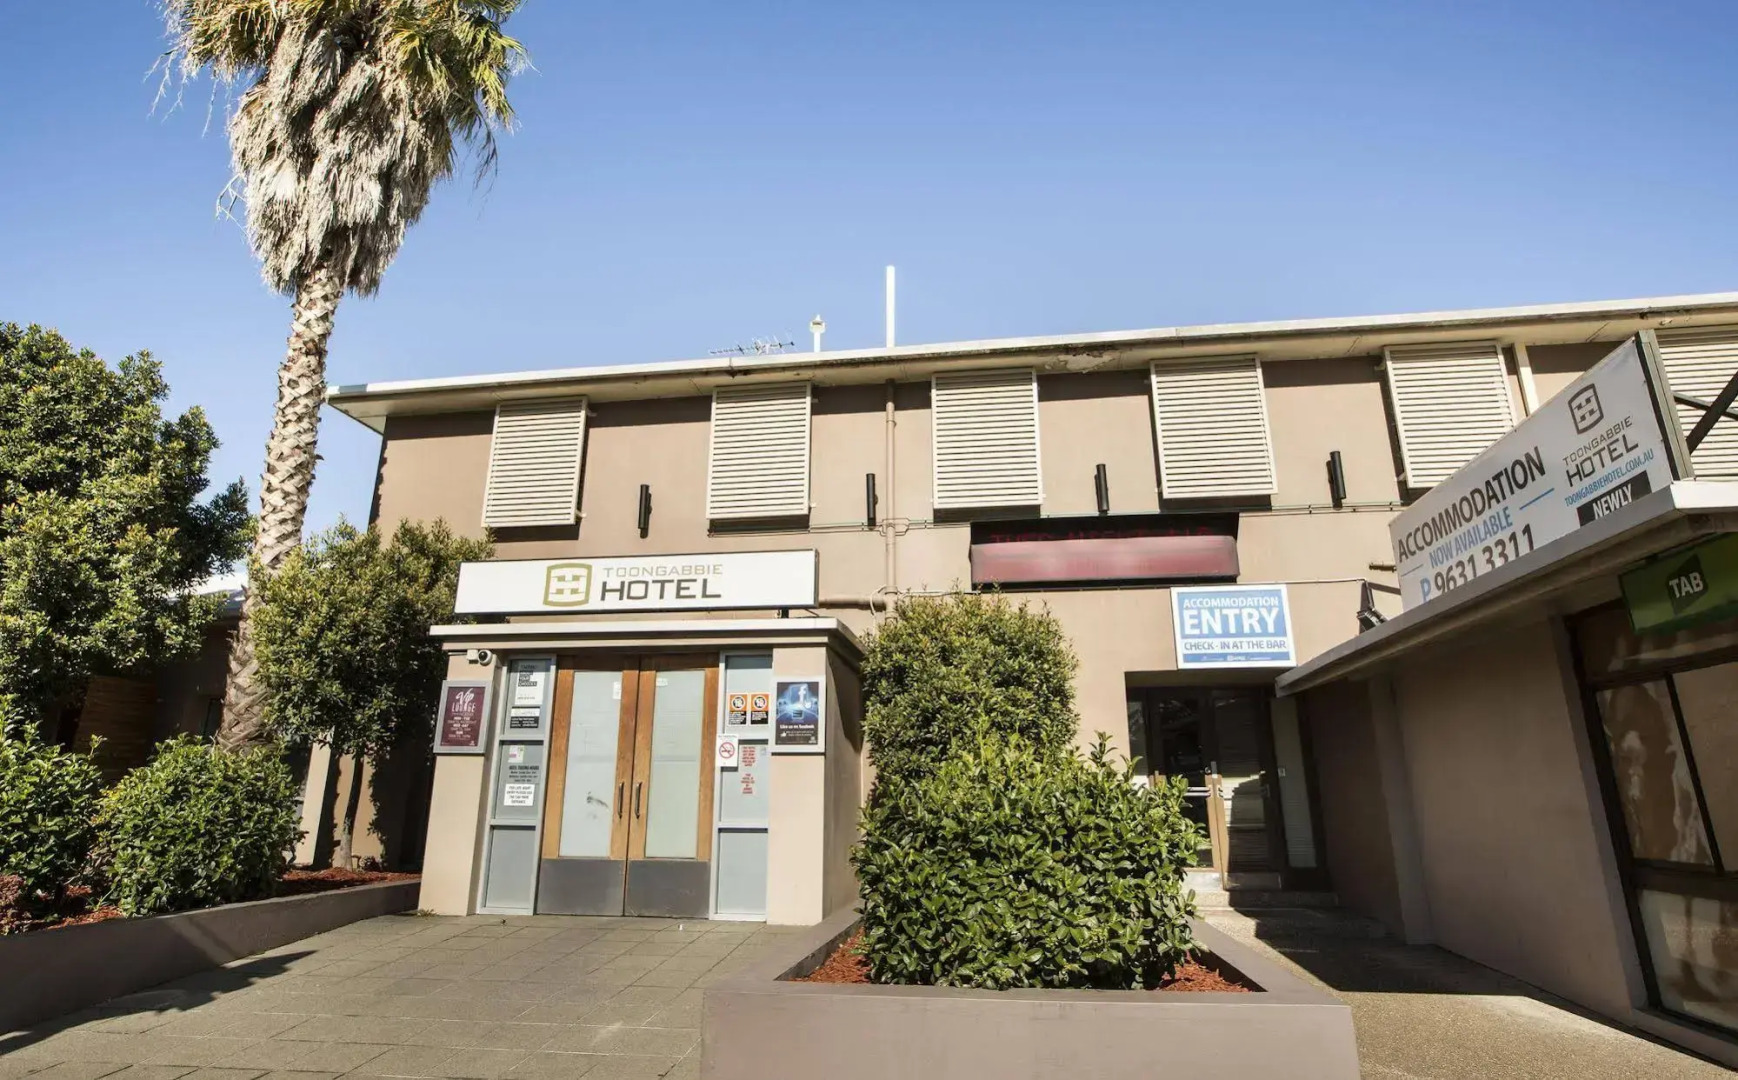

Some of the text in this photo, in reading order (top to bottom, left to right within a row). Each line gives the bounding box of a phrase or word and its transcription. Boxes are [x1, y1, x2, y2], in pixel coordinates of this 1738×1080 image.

[1563, 416, 1632, 465] TOONGABBIE
[1565, 448, 1655, 507] TOONGABBIEHOTEL.COM.AU
[1566, 434, 1639, 487] HOTEL
[1398, 446, 1546, 563] ACCOMMODATION
[1592, 483, 1633, 520] NEWLY
[1429, 506, 1513, 568] NOW AVAILABLE
[603, 564, 723, 578] TOONGABBIE
[1434, 554, 1477, 595] 9631
[1482, 523, 1534, 570] 3311
[600, 578, 722, 601] HOTEL
[1183, 597, 1279, 609] ACCOMMODATION
[1669, 572, 1704, 599] TAB
[1183, 607, 1279, 635] ENTRY
[1184, 641, 1214, 651] CHECK
[1220, 641, 1230, 650] IN
[1232, 641, 1245, 650] AT
[1246, 640, 1265, 650] THE
[1266, 640, 1287, 649] BAR
